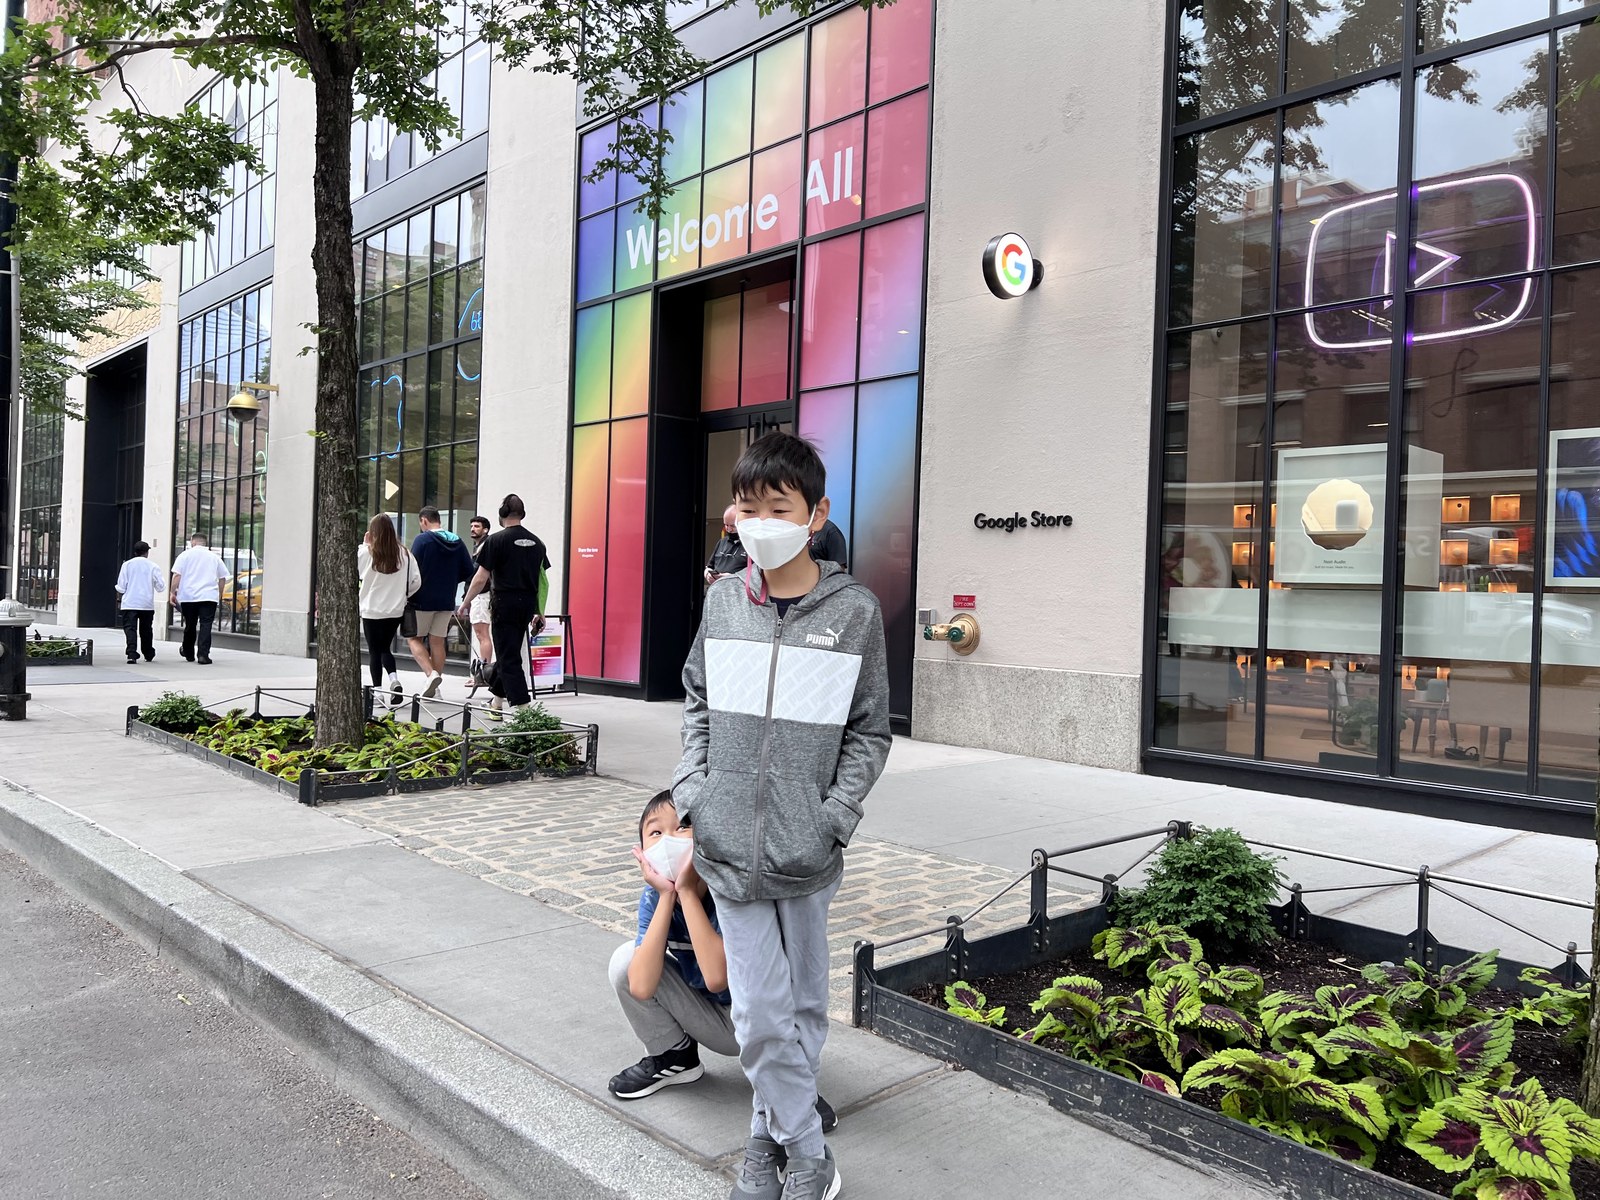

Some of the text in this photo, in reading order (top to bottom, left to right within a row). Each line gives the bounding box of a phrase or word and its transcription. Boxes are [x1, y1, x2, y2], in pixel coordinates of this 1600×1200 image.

[626, 146, 854, 270] Welcome All
[1001, 243, 1027, 286] G
[973, 510, 1073, 533] Google Store
[805, 633, 835, 647] PUMA
